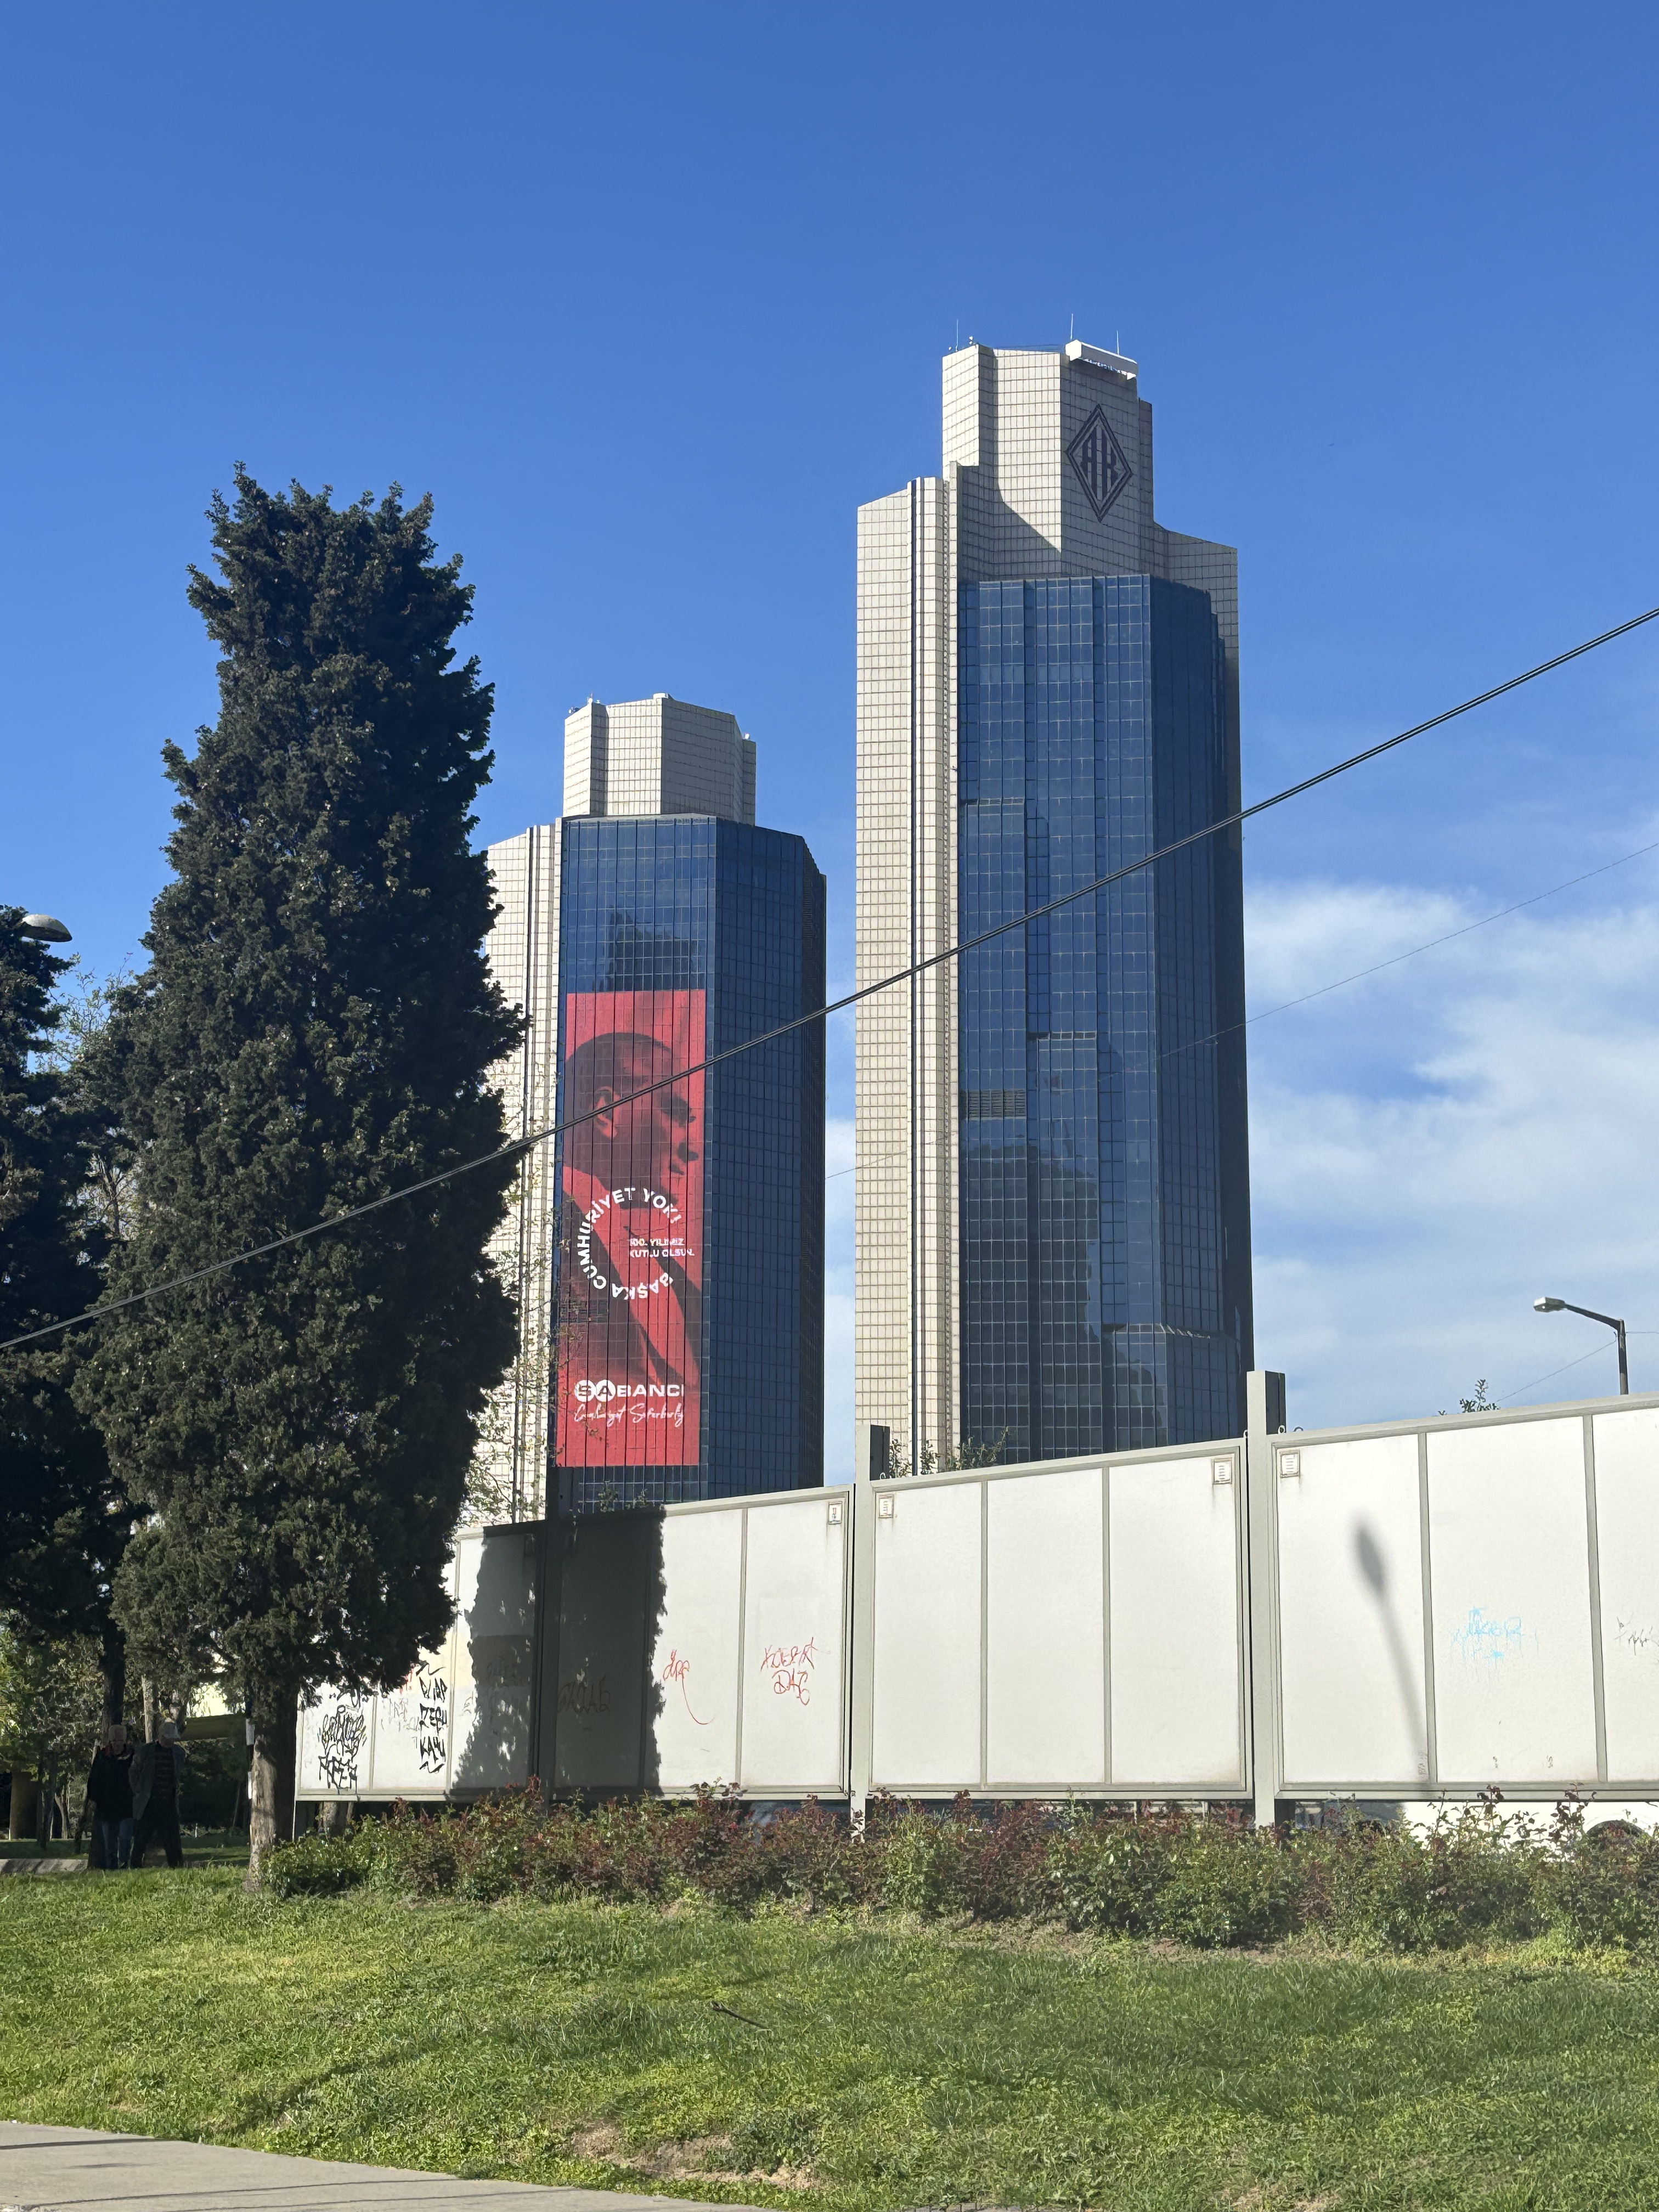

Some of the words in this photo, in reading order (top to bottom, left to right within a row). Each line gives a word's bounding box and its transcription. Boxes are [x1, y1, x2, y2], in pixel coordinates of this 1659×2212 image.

[644, 1188, 682, 1224] YOK!
[577, 1187, 636, 1289] CUMHURİYET
[612, 1272, 674, 1300] BAŞKA
[574, 1379, 684, 1402] SABANCI
